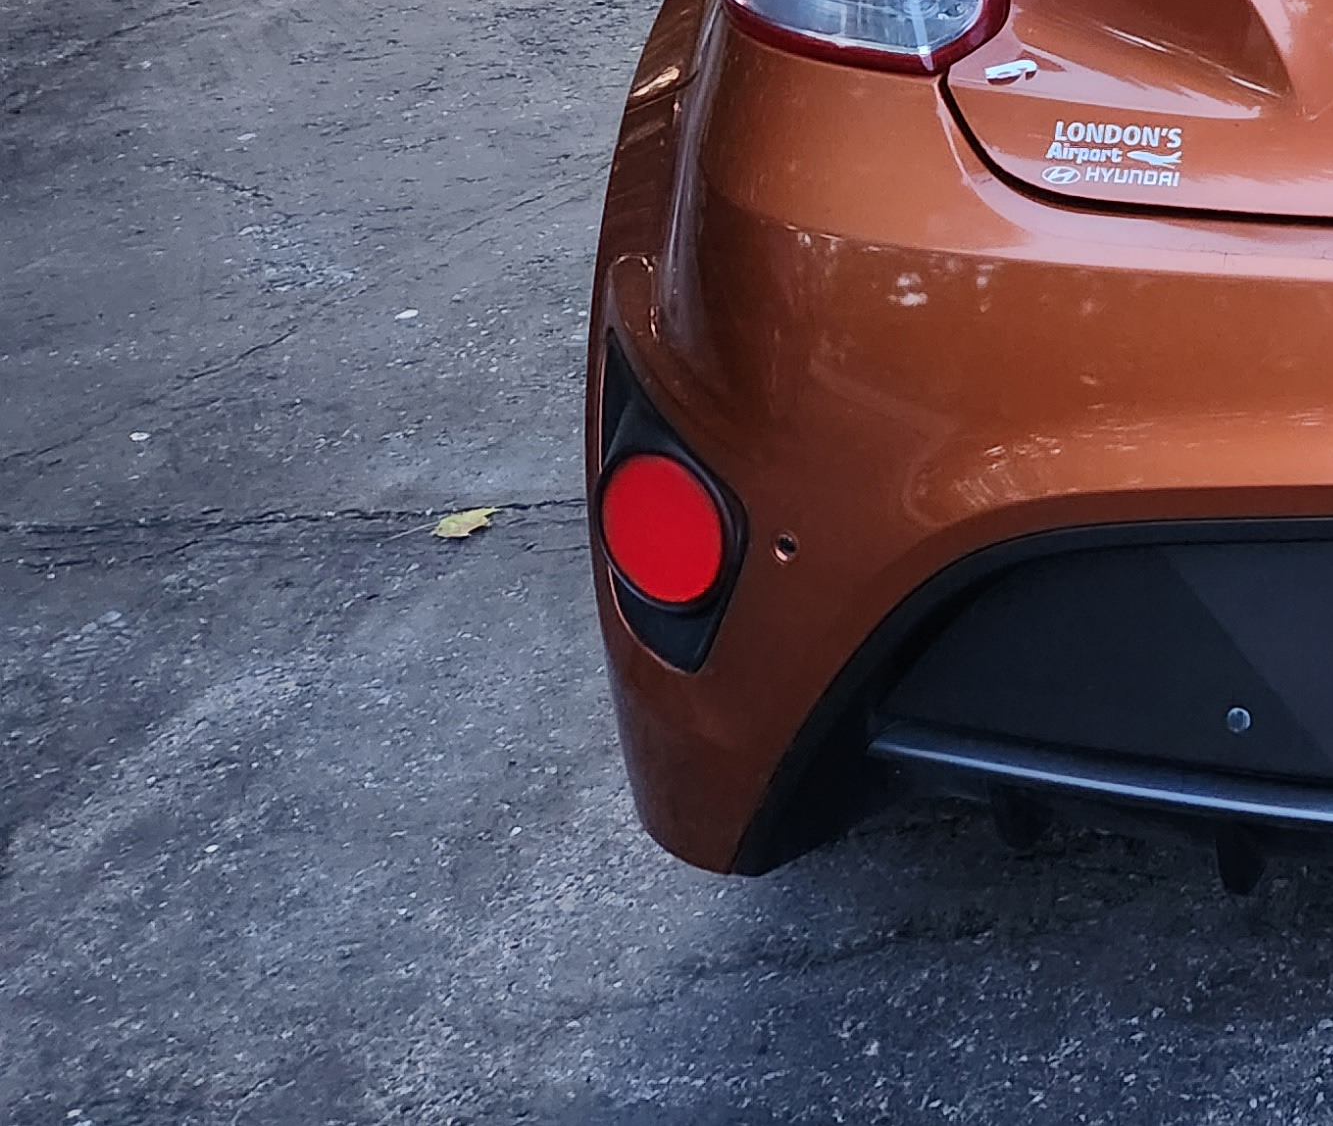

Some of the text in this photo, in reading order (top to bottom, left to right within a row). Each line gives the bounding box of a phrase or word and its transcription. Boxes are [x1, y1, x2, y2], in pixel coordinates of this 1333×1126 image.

[1054, 121, 1182, 148] LONDON'S
[1046, 142, 1122, 163] Airport
[1085, 166, 1179, 186] HYUNDAI
